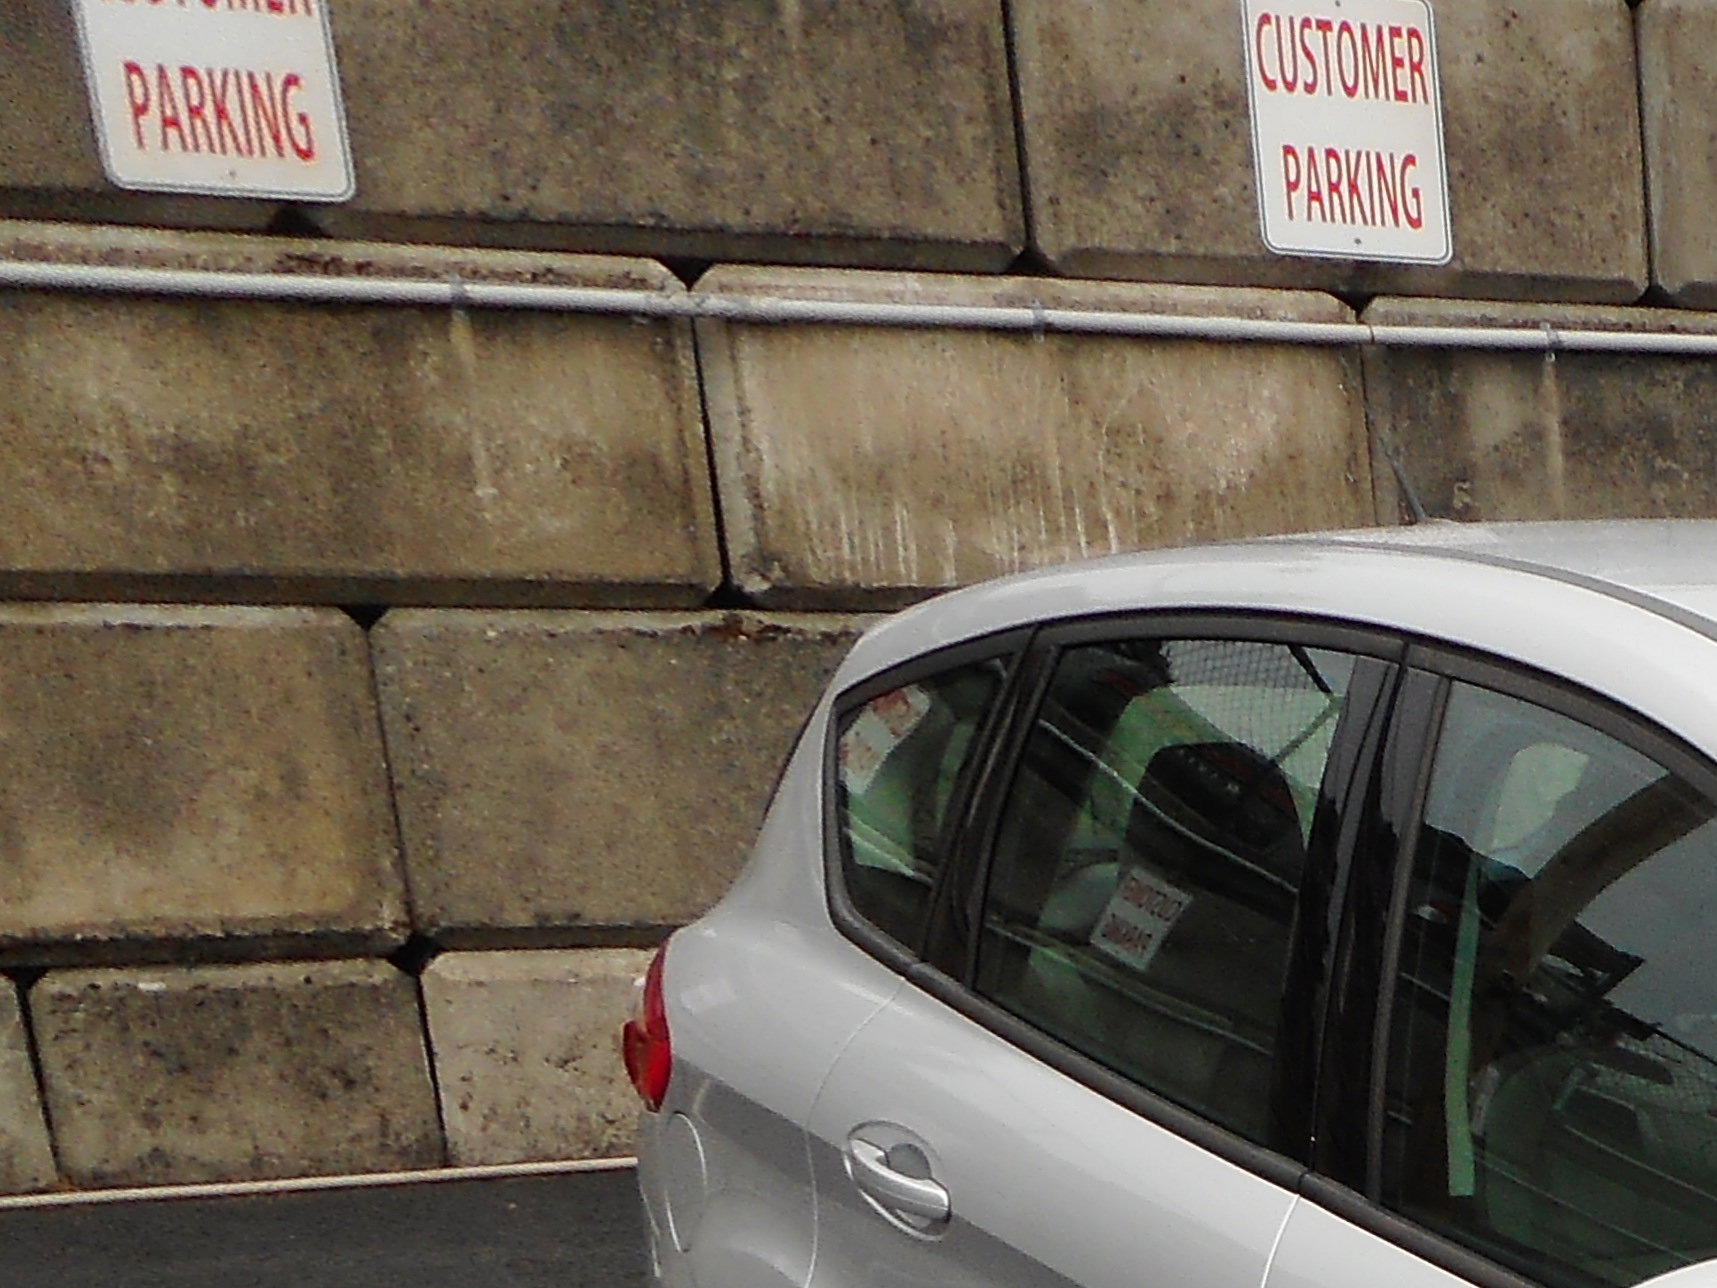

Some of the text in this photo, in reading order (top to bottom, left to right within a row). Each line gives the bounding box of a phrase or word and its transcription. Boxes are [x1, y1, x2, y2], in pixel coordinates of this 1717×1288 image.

[1256, 12, 1429, 105] CUSTOMER
[123, 61, 315, 161] PARKING
[1282, 144, 1423, 230] PARKING
